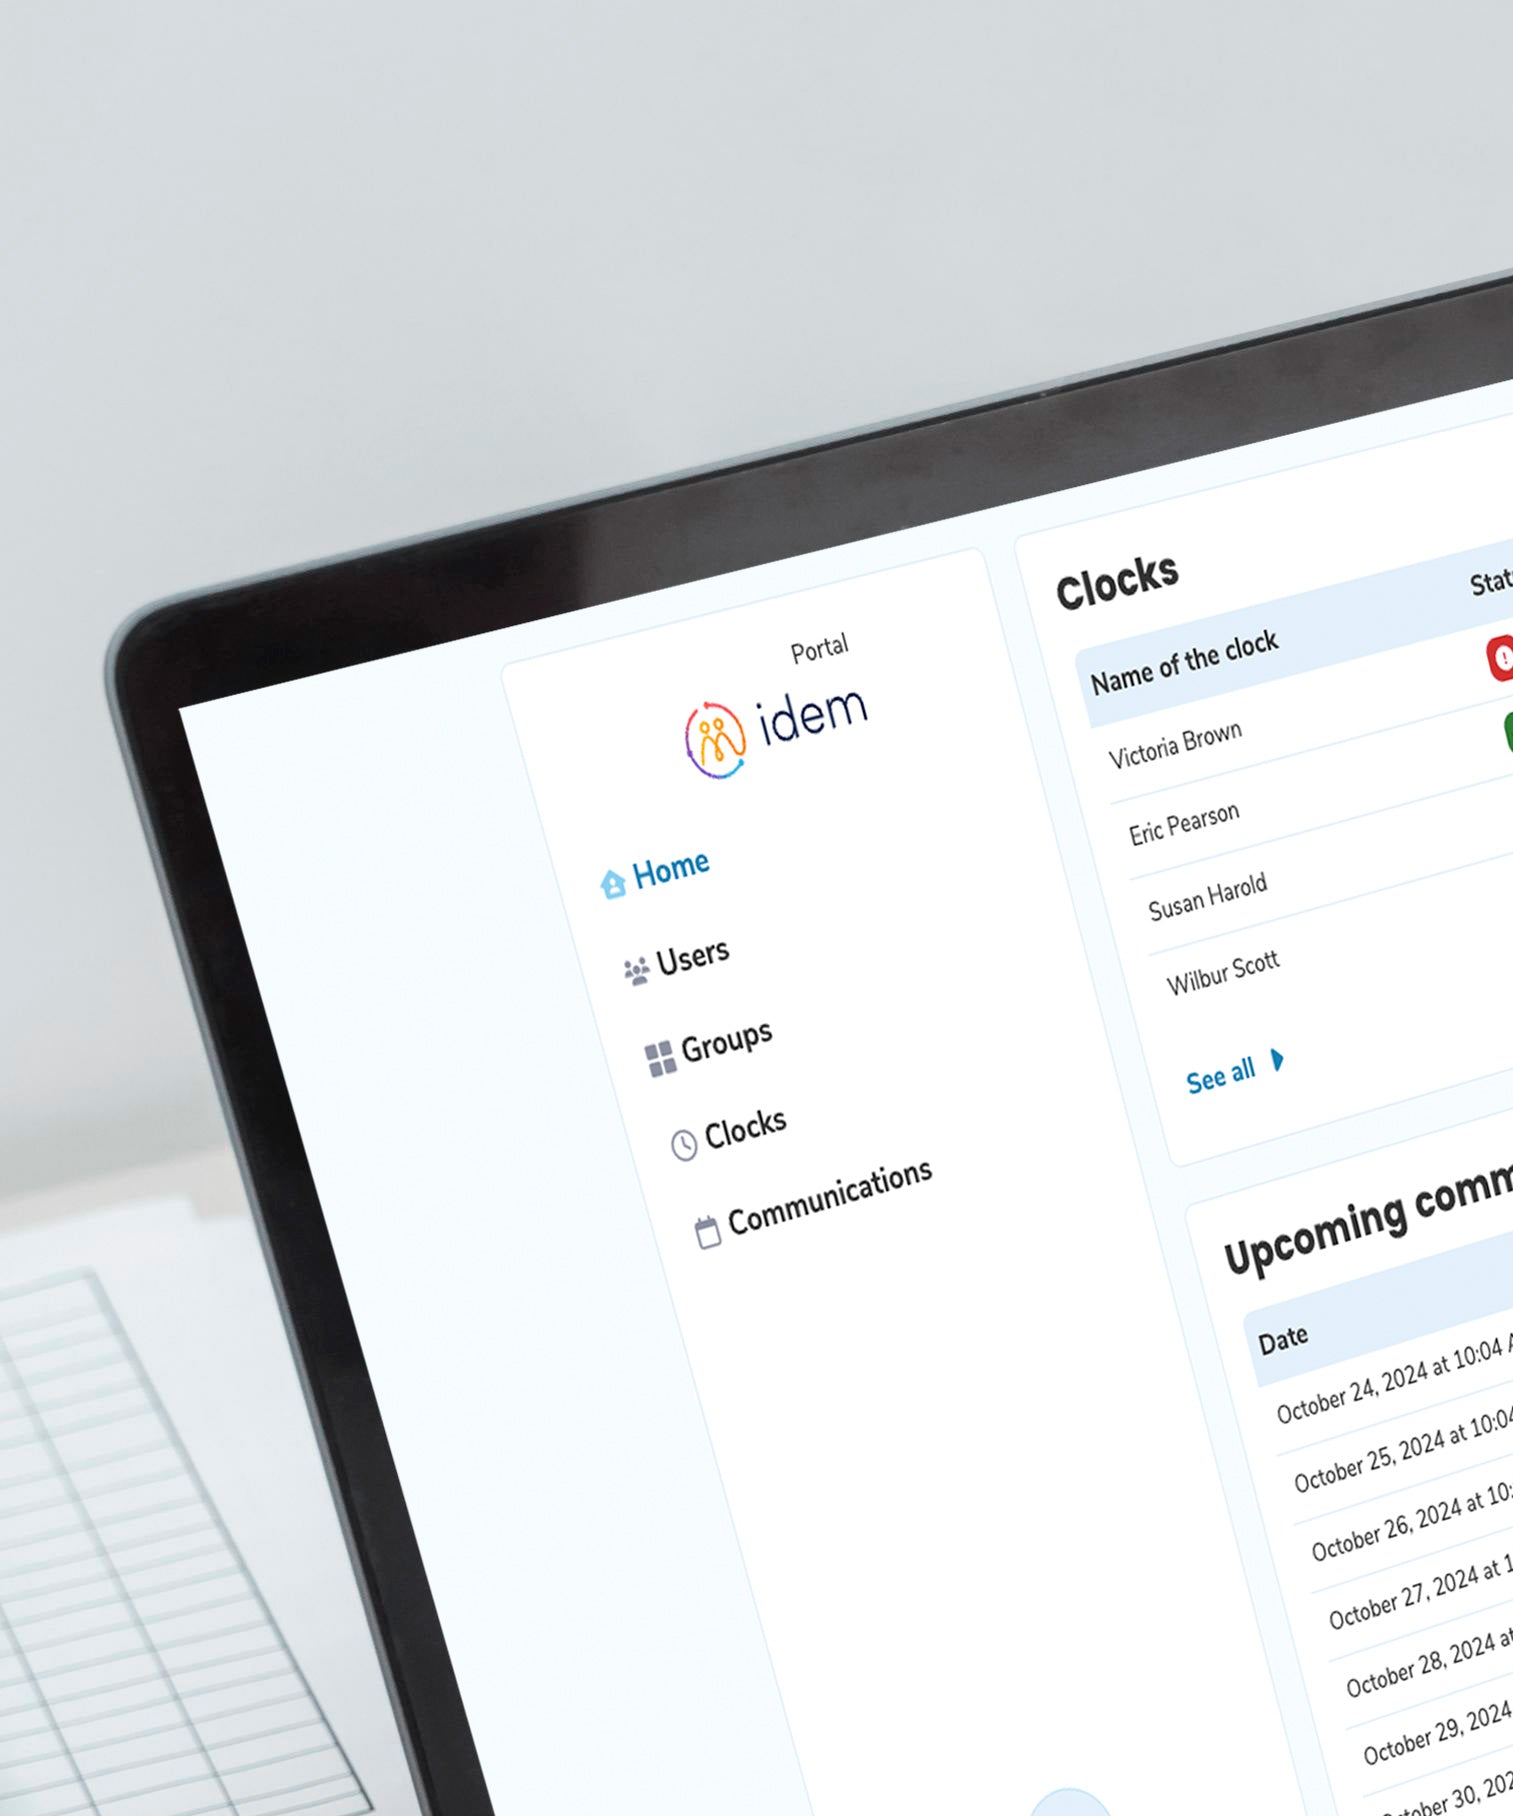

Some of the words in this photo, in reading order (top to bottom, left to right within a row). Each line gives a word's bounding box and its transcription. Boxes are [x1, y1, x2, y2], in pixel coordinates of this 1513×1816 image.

[1057, 557, 1179, 610] Clocks
[792, 632, 848, 664] Portal
[1091, 667, 1153, 695] Name
[1160, 653, 1179, 677] of
[1185, 648, 1220, 670] the
[1226, 630, 1279, 660] clock
[757, 693, 867, 745] idem
[1109, 738, 1179, 768] Victoria
[1182, 724, 1242, 751] Brown
[1130, 822, 1164, 846] Eric
[1167, 805, 1239, 835] Pearson
[633, 854, 710, 888] Home
[1149, 895, 1205, 921] Susan
[1208, 872, 1267, 905] Harold
[657, 942, 730, 975] Users
[1167, 968, 1228, 995] Wilbur
[1232, 951, 1280, 978] Scott
[682, 1024, 773, 1062] Groups
[1187, 1071, 1226, 1094] See
[1232, 1056, 1255, 1081] all
[706, 1110, 786, 1148] Clocks
[729, 1162, 932, 1234] Communications
[1225, 1199, 1408, 1280] Upcoming
[1259, 1328, 1308, 1355] Date
[1278, 1391, 1346, 1423] October
[1350, 1379, 1379, 1401] 24,
[1382, 1362, 1427, 1391] 2024
[1433, 1357, 1450, 1375] at
[1454, 1338, 1503, 1369] 10:04
